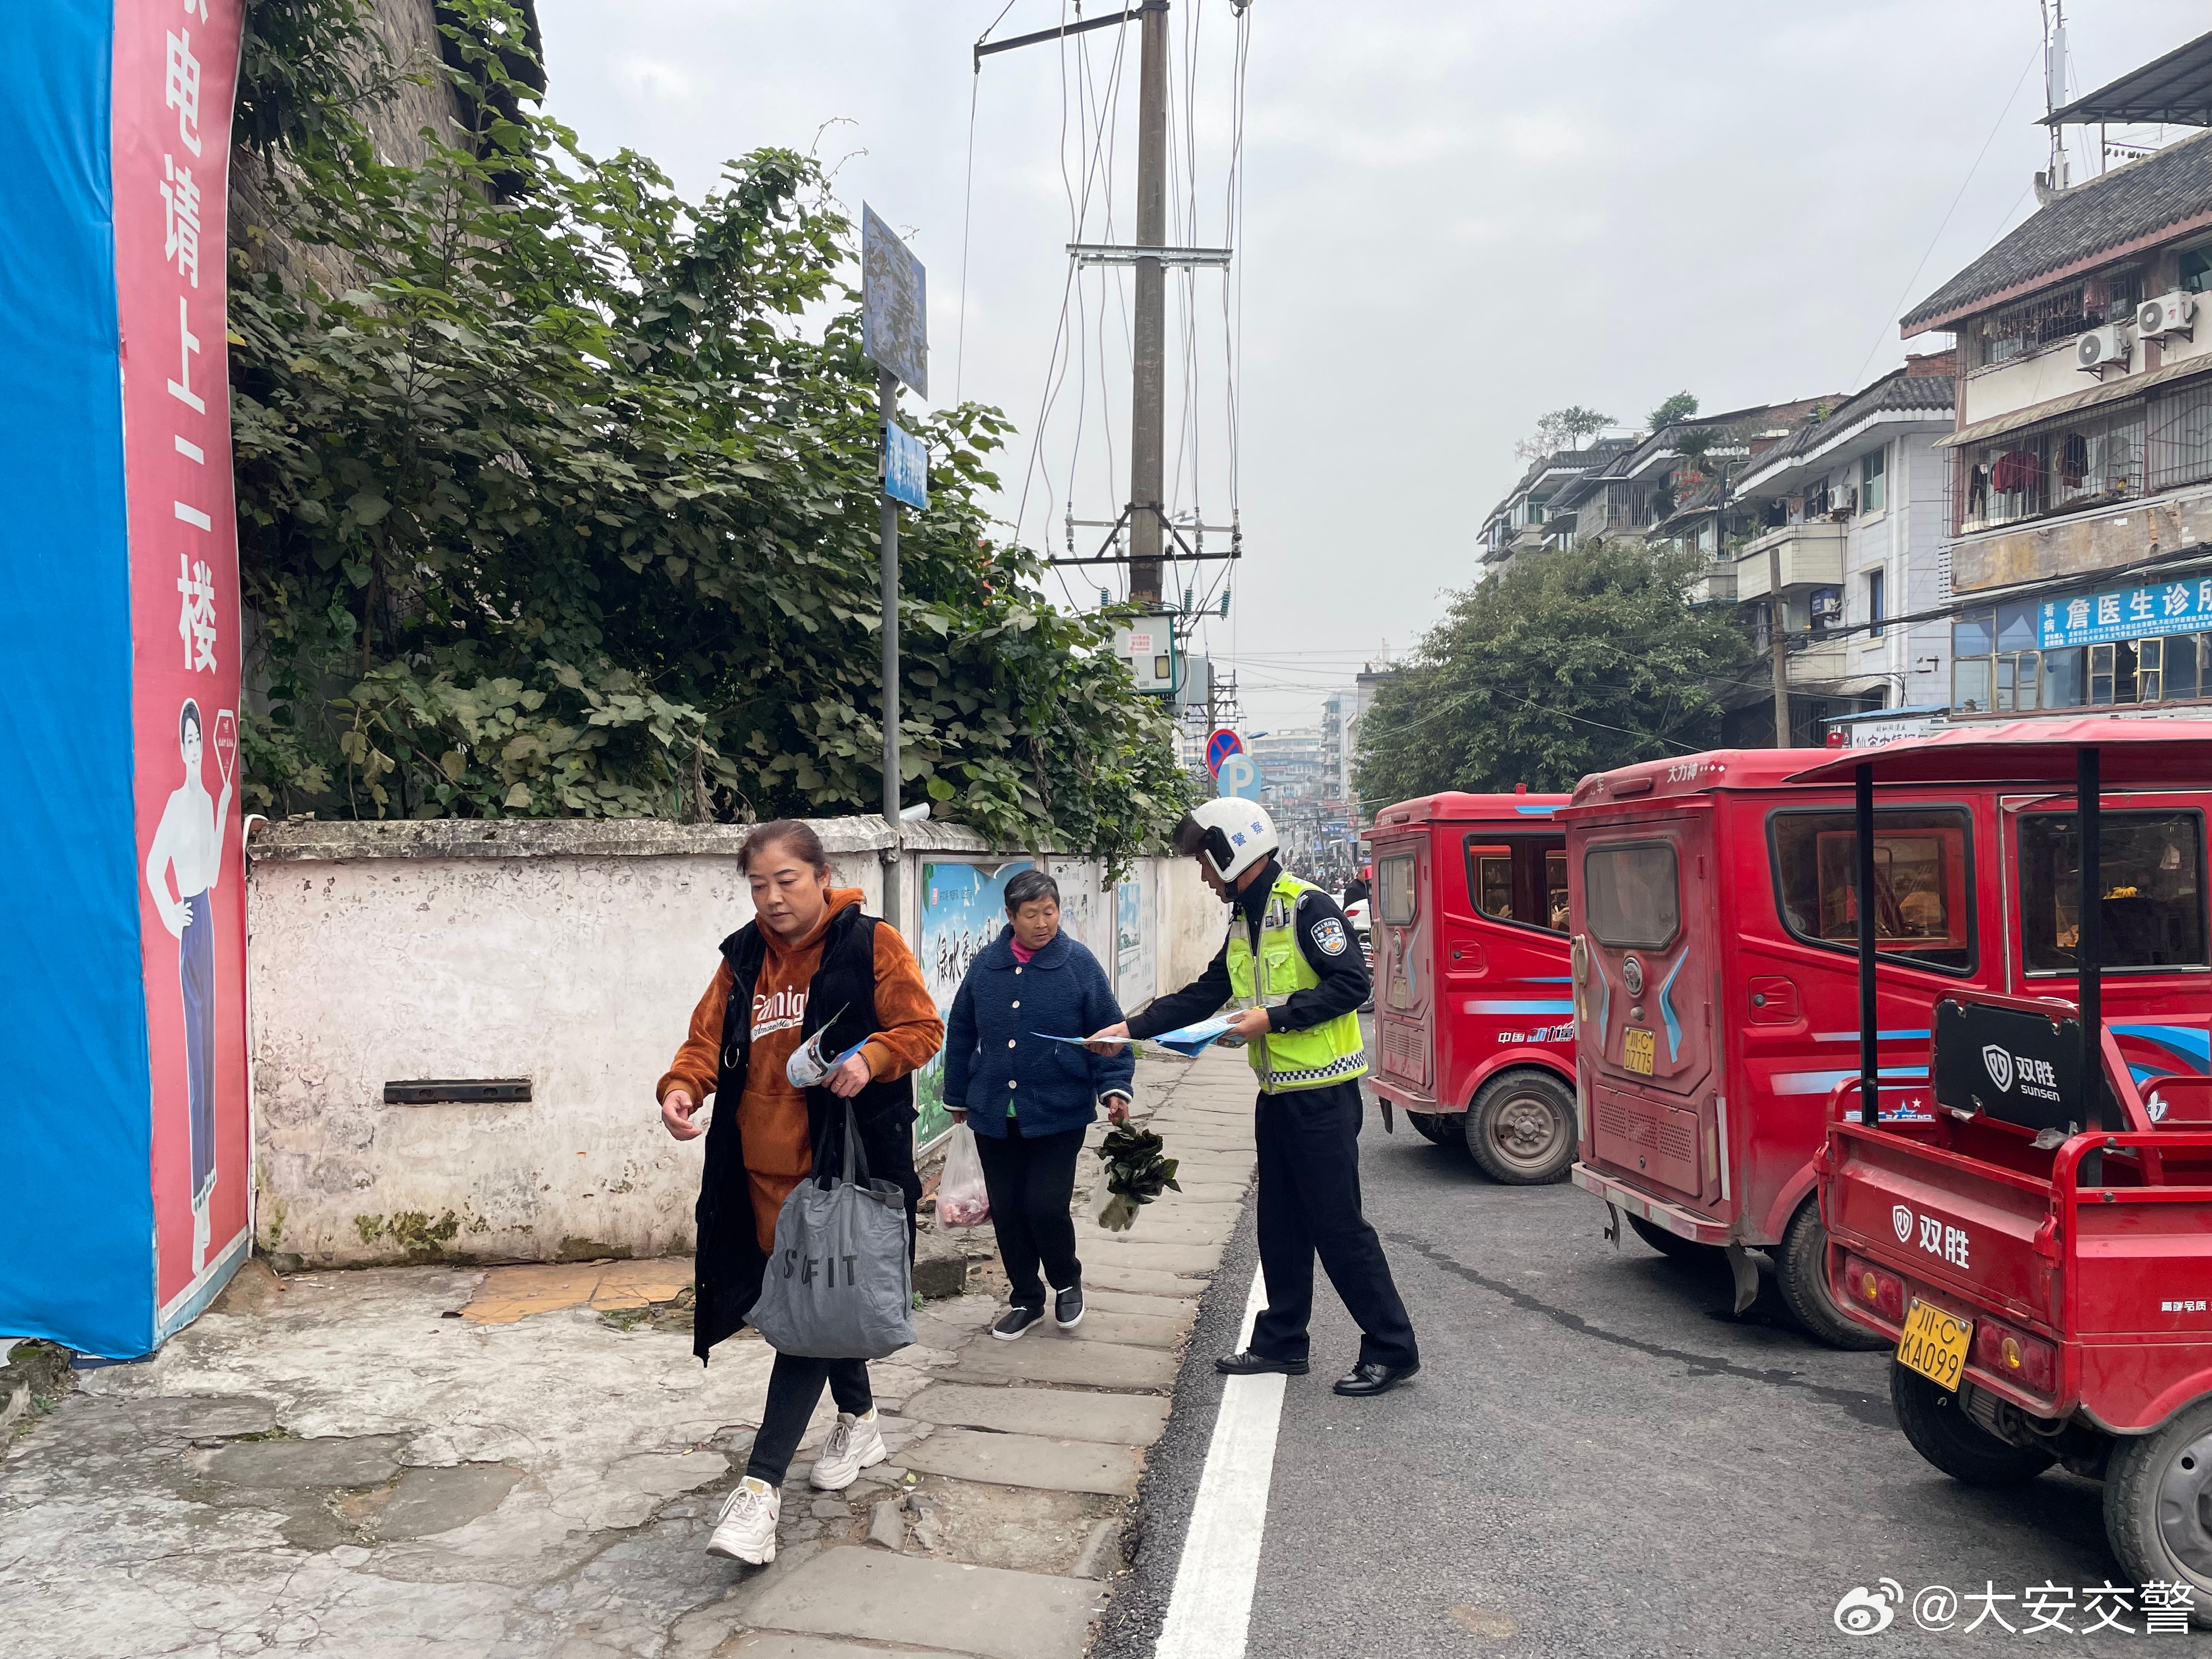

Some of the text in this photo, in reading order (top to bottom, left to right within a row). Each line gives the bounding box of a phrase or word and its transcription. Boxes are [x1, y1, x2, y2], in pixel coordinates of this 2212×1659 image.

[2044, 603, 2055, 633] 看病
[1229, 760, 1254, 797] P
[1667, 762, 1698, 783] 大力神
[1231, 821, 1264, 847] 警察
[1625, 1048, 1652, 1073] DZ775
[2015, 1056, 2057, 1088] 双胜
[1919, 1214, 1970, 1269] 双胜
[2162, 1300, 2207, 1312] 高端品质
[1900, 1330, 1959, 1383] KA099
